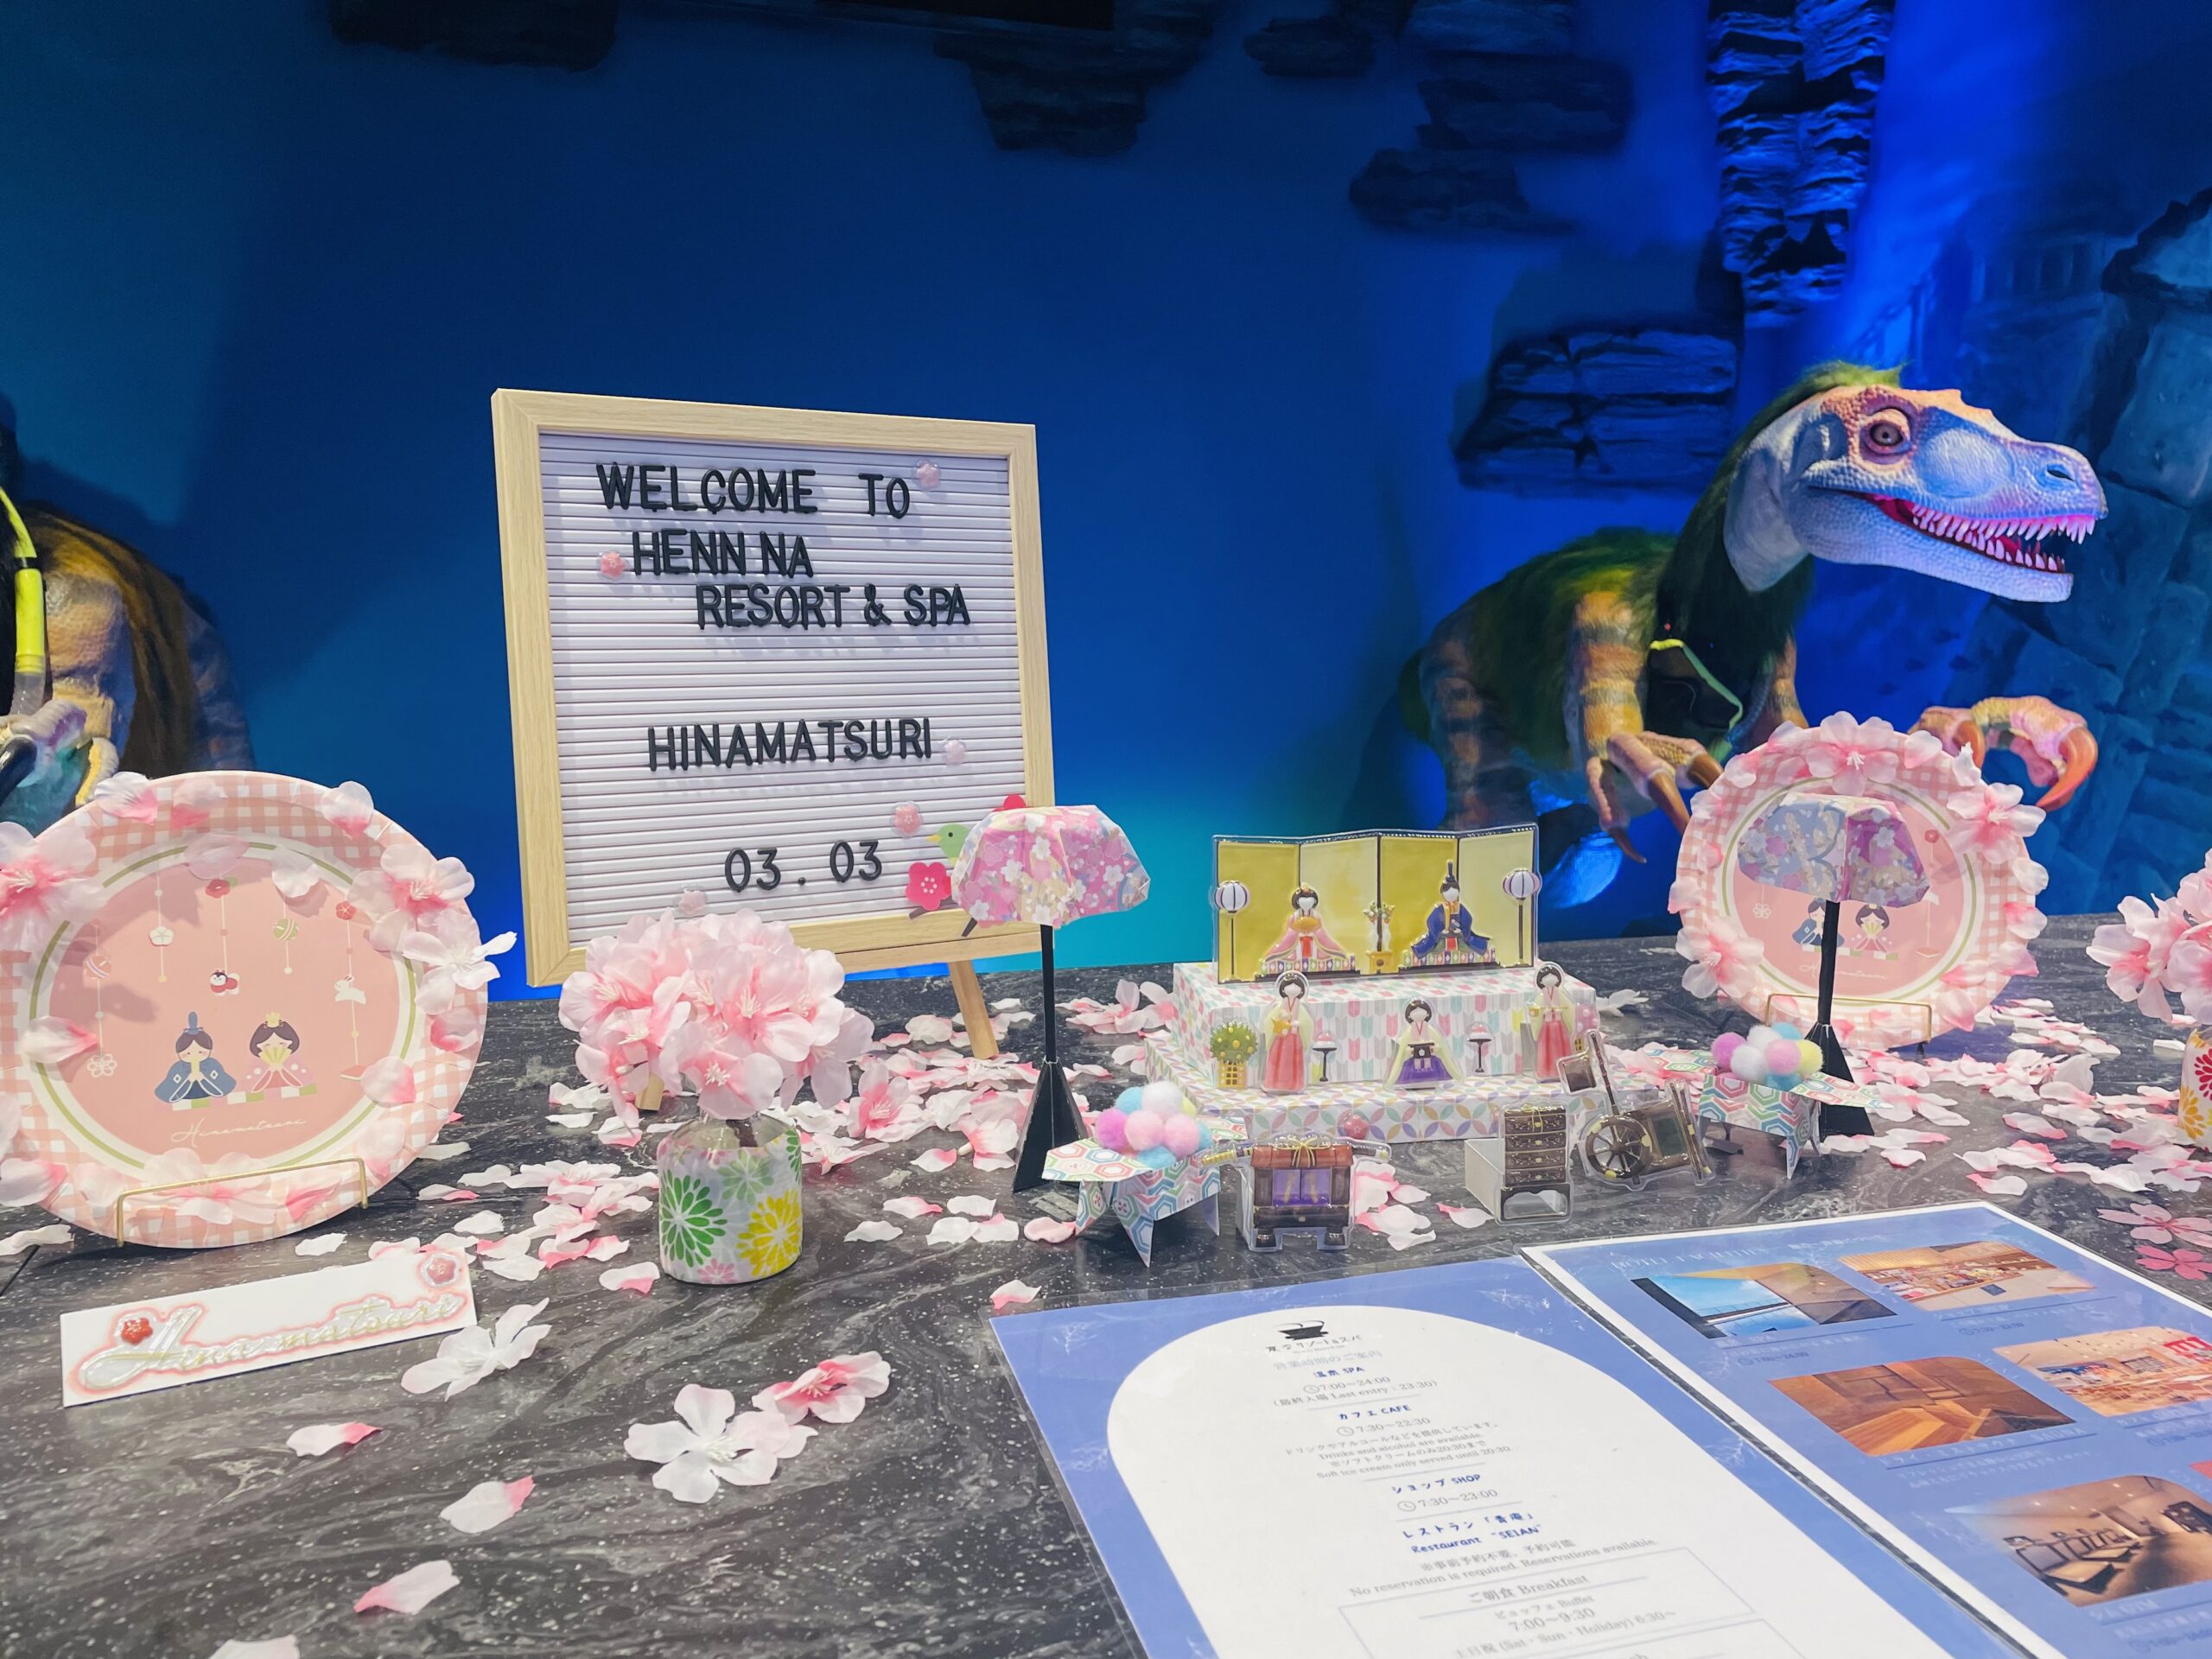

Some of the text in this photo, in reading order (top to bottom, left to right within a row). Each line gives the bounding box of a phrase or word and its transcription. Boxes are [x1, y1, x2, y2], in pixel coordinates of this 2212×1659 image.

[596, 461, 911, 518] WELCOME TO
[632, 528, 814, 578] HENN NA
[695, 583, 970, 630] RESORT & SPA
[648, 717, 931, 771] HINAMATSURI
[1343, 1366, 1364, 1375] SPA
[1332, 1390, 1356, 1400] Last
[1359, 1388, 1388, 1397] entry
[1381, 1404, 1412, 1414] CAFE
[1319, 1450, 1355, 1460] Drinks
[1379, 1441, 1417, 1452] alcohol
[1360, 1463, 1392, 1474] cream
[1394, 1459, 1417, 1470] only
[1419, 1454, 1453, 1465] served
[1455, 1449, 1479, 1459] until
[1391, 1474, 1481, 1494] ショップ SHOP
[1402, 1522, 1473, 1539] レストラン
[1411, 1536, 1482, 1554] Restaurant
[1350, 1586, 1371, 1597] No
[1375, 1575, 1446, 1593] reservation
[1449, 1573, 1460, 1581] is
[1462, 1562, 1517, 1581] required.
[1521, 1548, 1601, 1567] Reservations
[1469, 1574, 1591, 1603] ご朝食 Breakfast
[1558, 1594, 1596, 1608] Buffet
